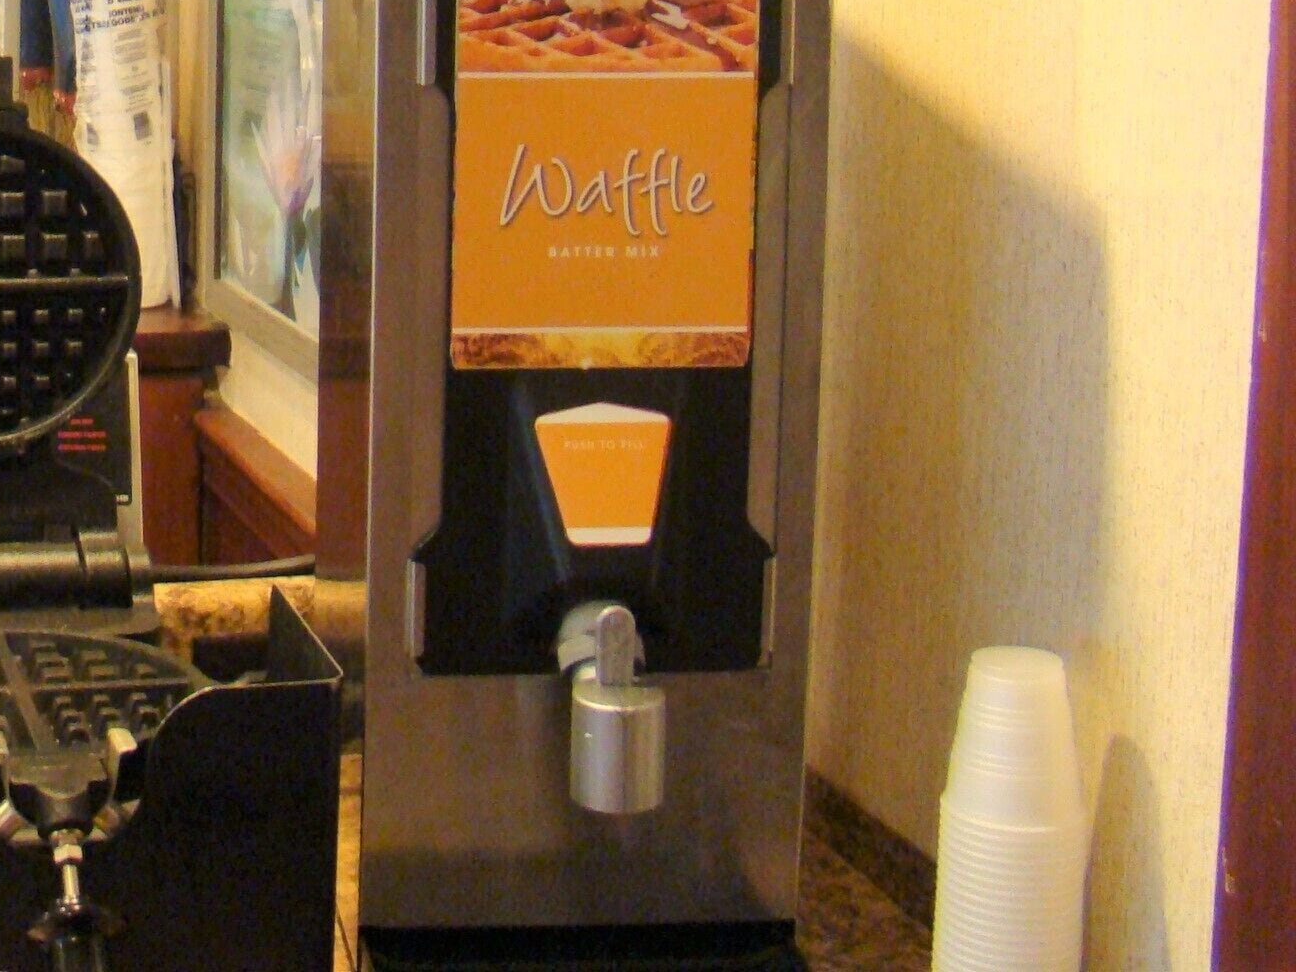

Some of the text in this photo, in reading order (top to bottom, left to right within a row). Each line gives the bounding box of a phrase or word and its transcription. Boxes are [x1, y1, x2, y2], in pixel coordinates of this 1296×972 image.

[500, 143, 714, 236] Waffle
[547, 244, 660, 259] BATTER MIX
[601, 439, 616, 450] TO
